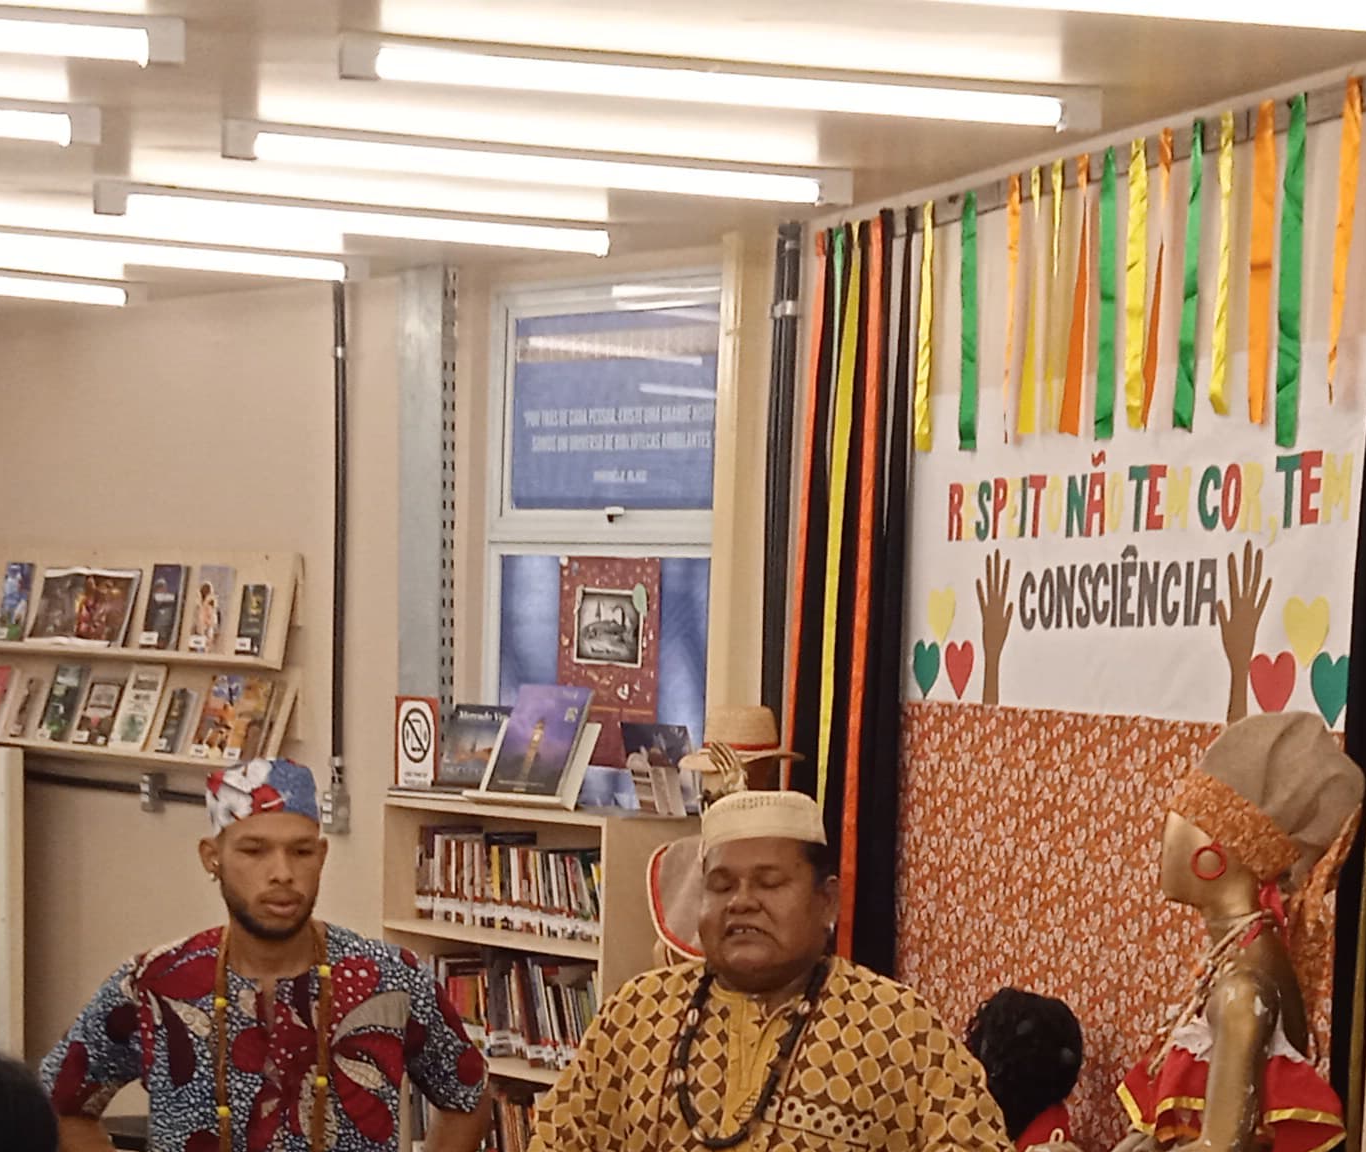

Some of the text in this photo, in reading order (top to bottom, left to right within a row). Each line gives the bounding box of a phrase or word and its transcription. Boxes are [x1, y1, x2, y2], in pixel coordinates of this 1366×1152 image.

[948, 474, 1063, 541] RESPEITO
[1065, 451, 1123, 538] NÃO
[1129, 464, 1192, 532] TEM
[1276, 450, 1354, 529] TEM
[1019, 545, 1217, 630] CONSCIÊNCIA
